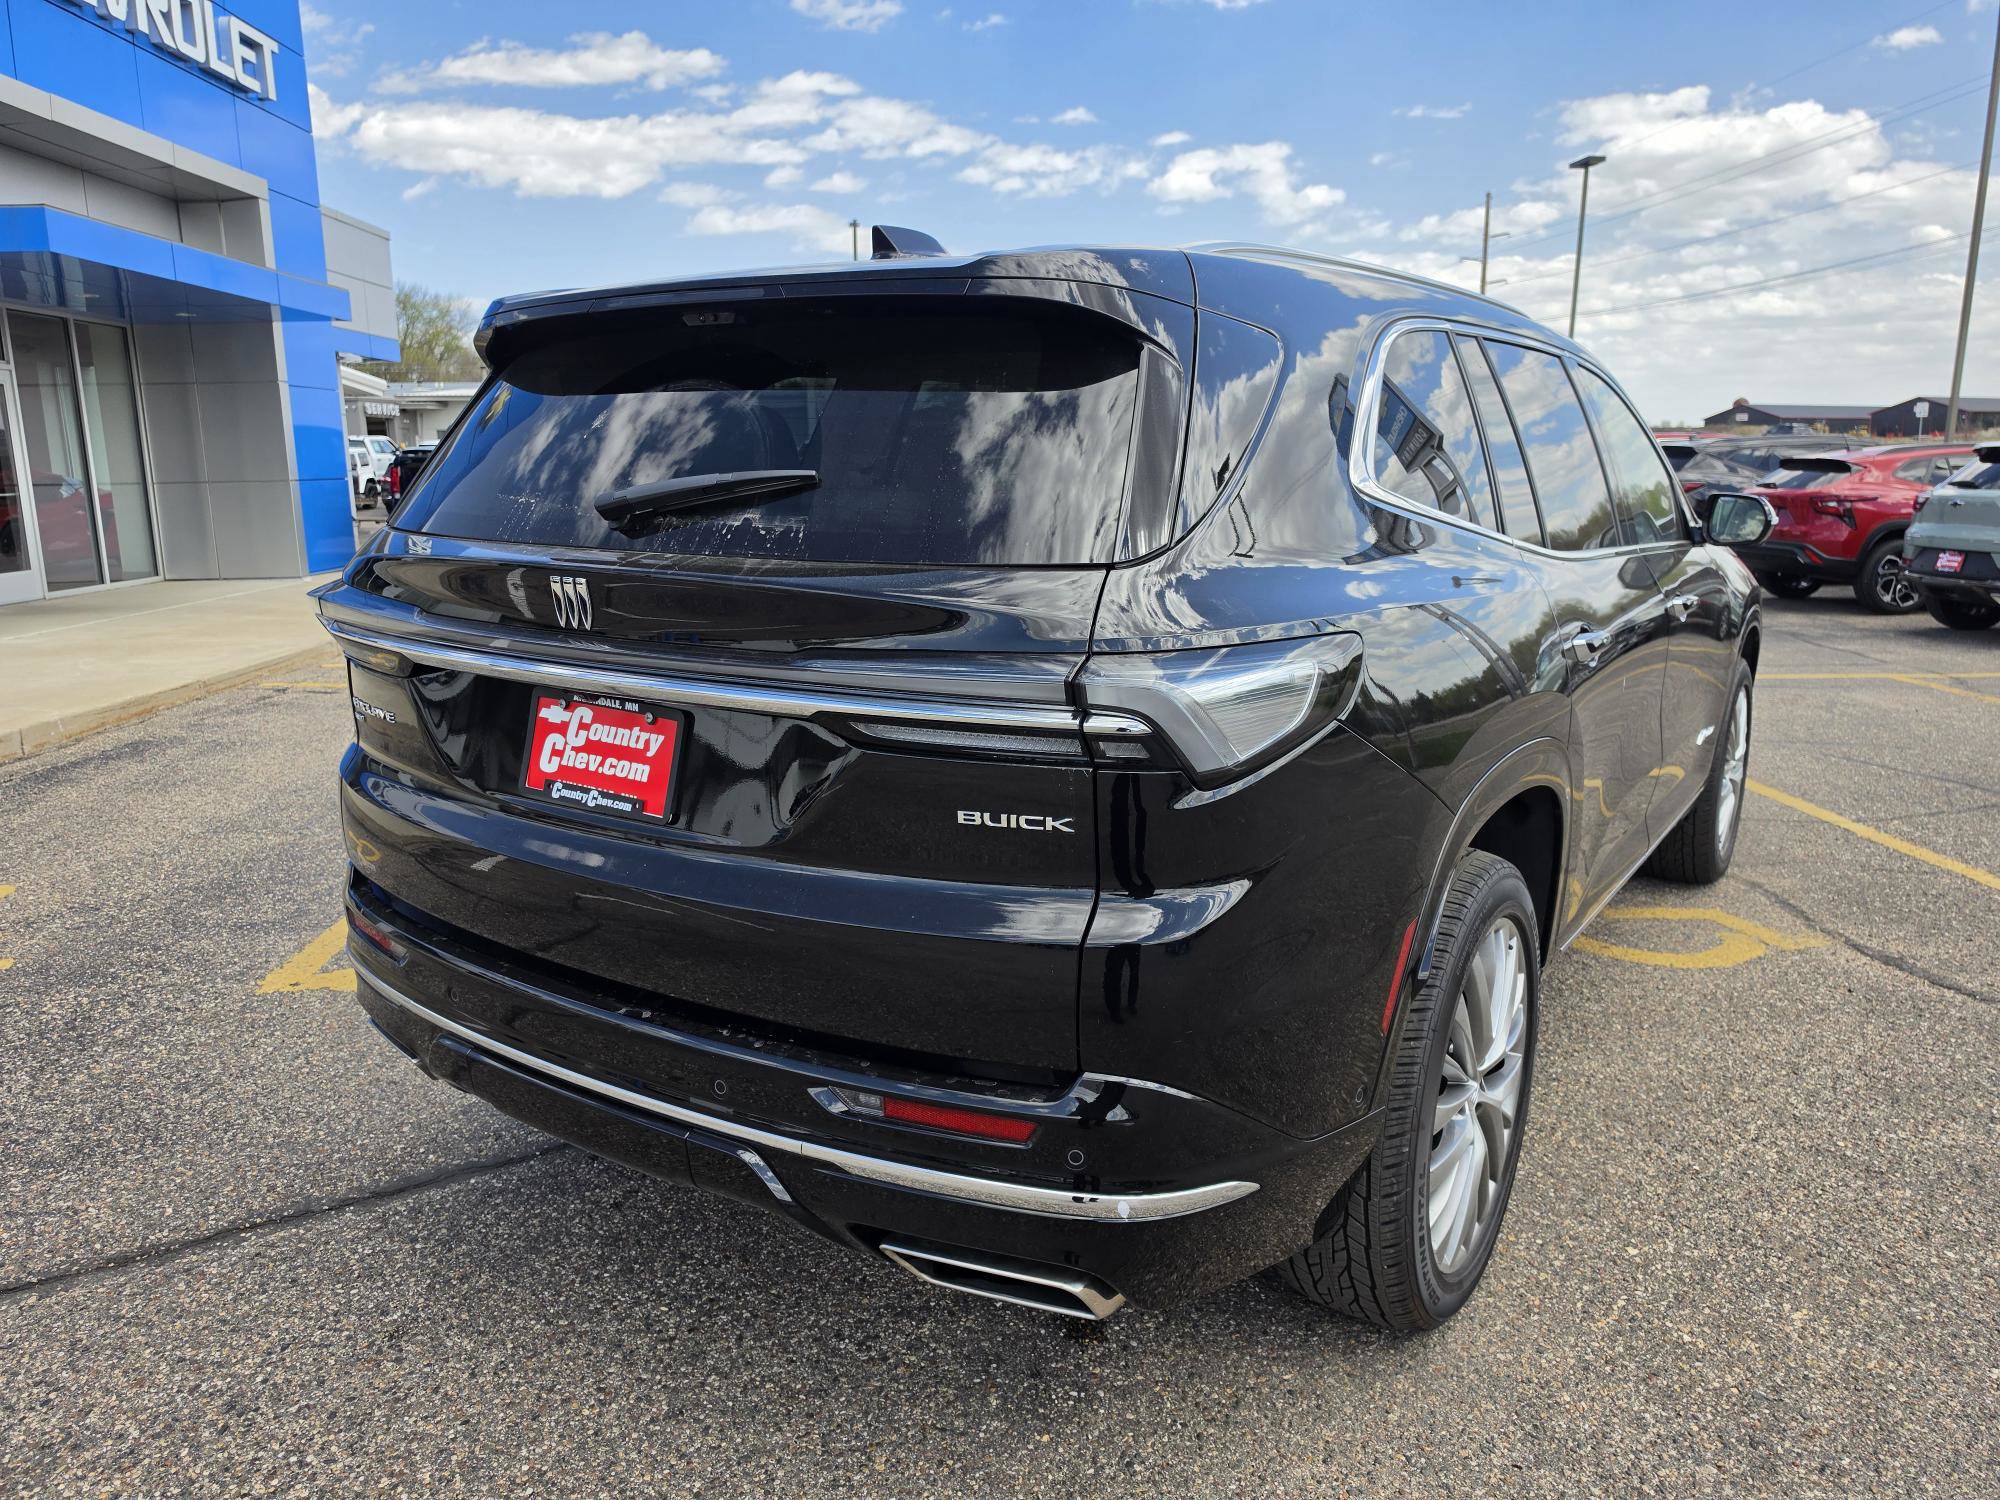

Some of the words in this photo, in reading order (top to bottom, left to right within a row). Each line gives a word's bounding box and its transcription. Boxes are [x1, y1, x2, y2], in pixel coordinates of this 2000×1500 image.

[566, 706, 665, 757] Country
[539, 733, 651, 783] Chev.com
[551, 781, 633, 812] CountryChev.com
[957, 810, 1076, 833] BUICK
[1417, 1162, 1441, 1307] CONTINENTAL
